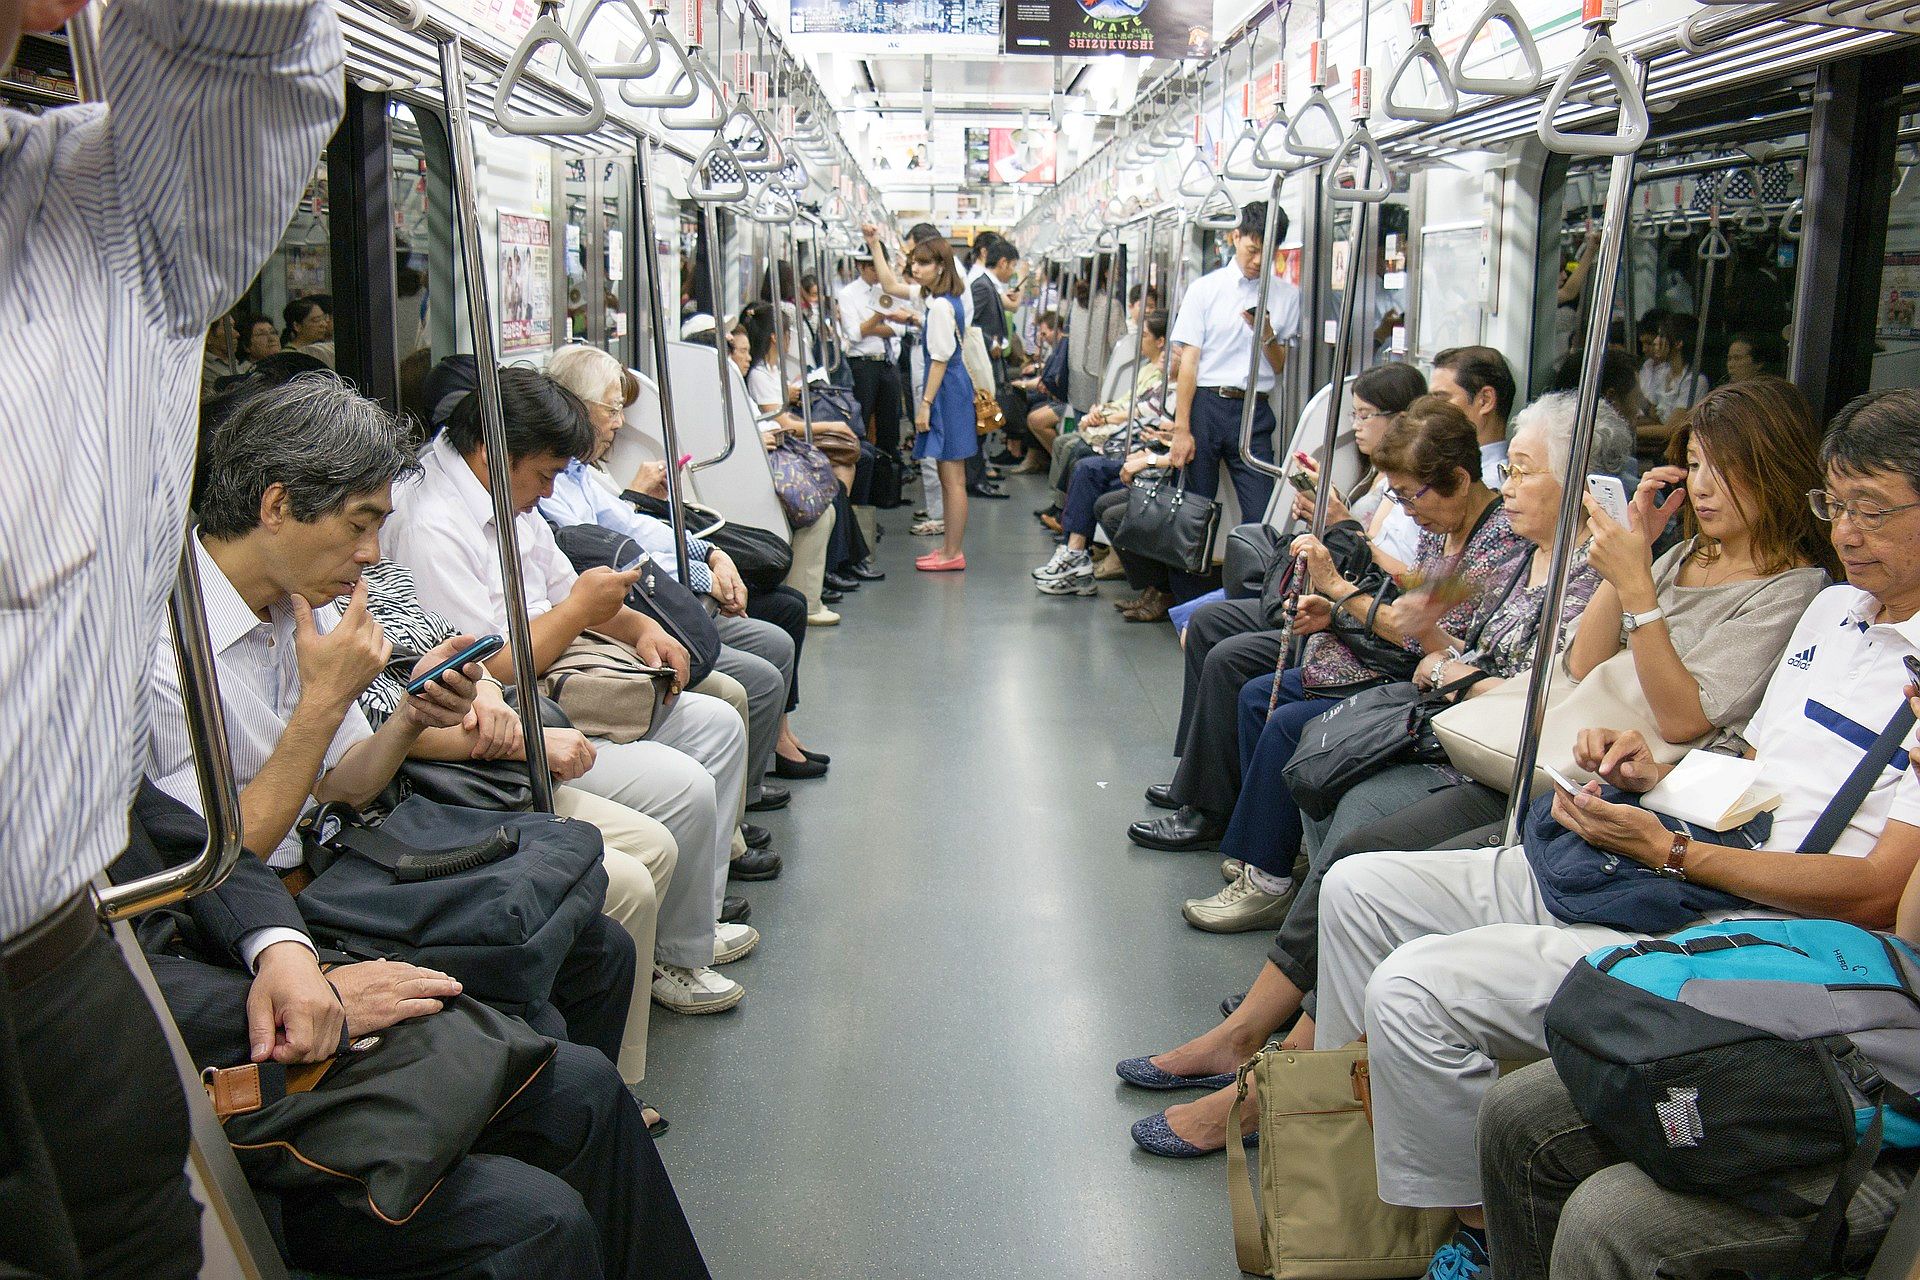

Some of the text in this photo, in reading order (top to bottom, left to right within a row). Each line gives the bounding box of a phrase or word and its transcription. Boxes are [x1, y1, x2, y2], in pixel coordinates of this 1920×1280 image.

[1083, 15, 1142, 32] IWATE
[1069, 39, 1154, 50] SHIZUKUISHI
[1833, 949, 1848, 971] HEAD
